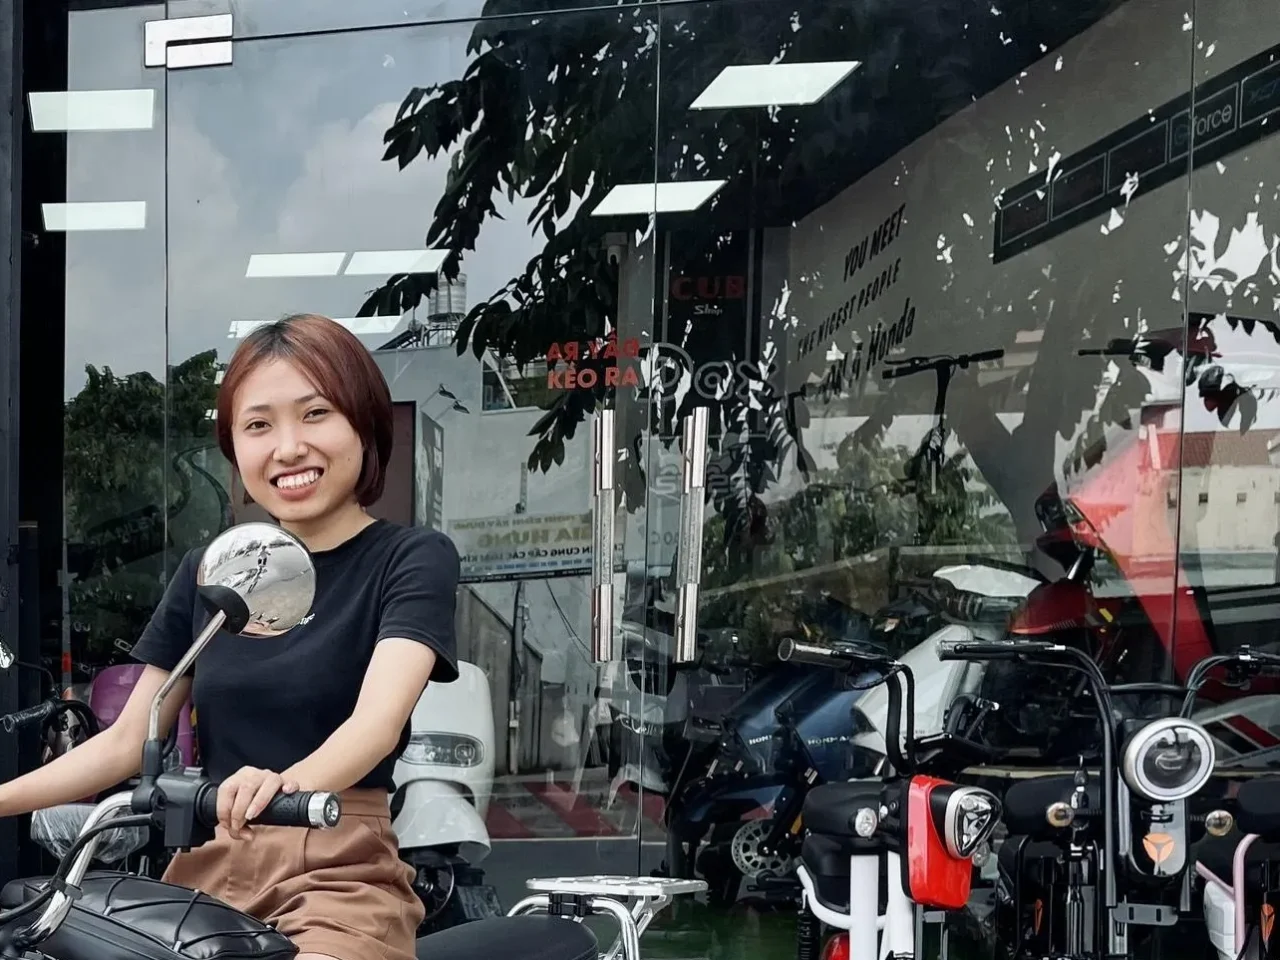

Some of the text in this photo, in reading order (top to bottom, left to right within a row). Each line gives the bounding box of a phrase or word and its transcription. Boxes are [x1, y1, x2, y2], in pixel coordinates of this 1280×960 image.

[844, 203, 906, 283] YOU MEET
[857, 257, 901, 313] PEOPLE
[867, 297, 916, 371] Honda
[605, 366, 639, 387] RA
